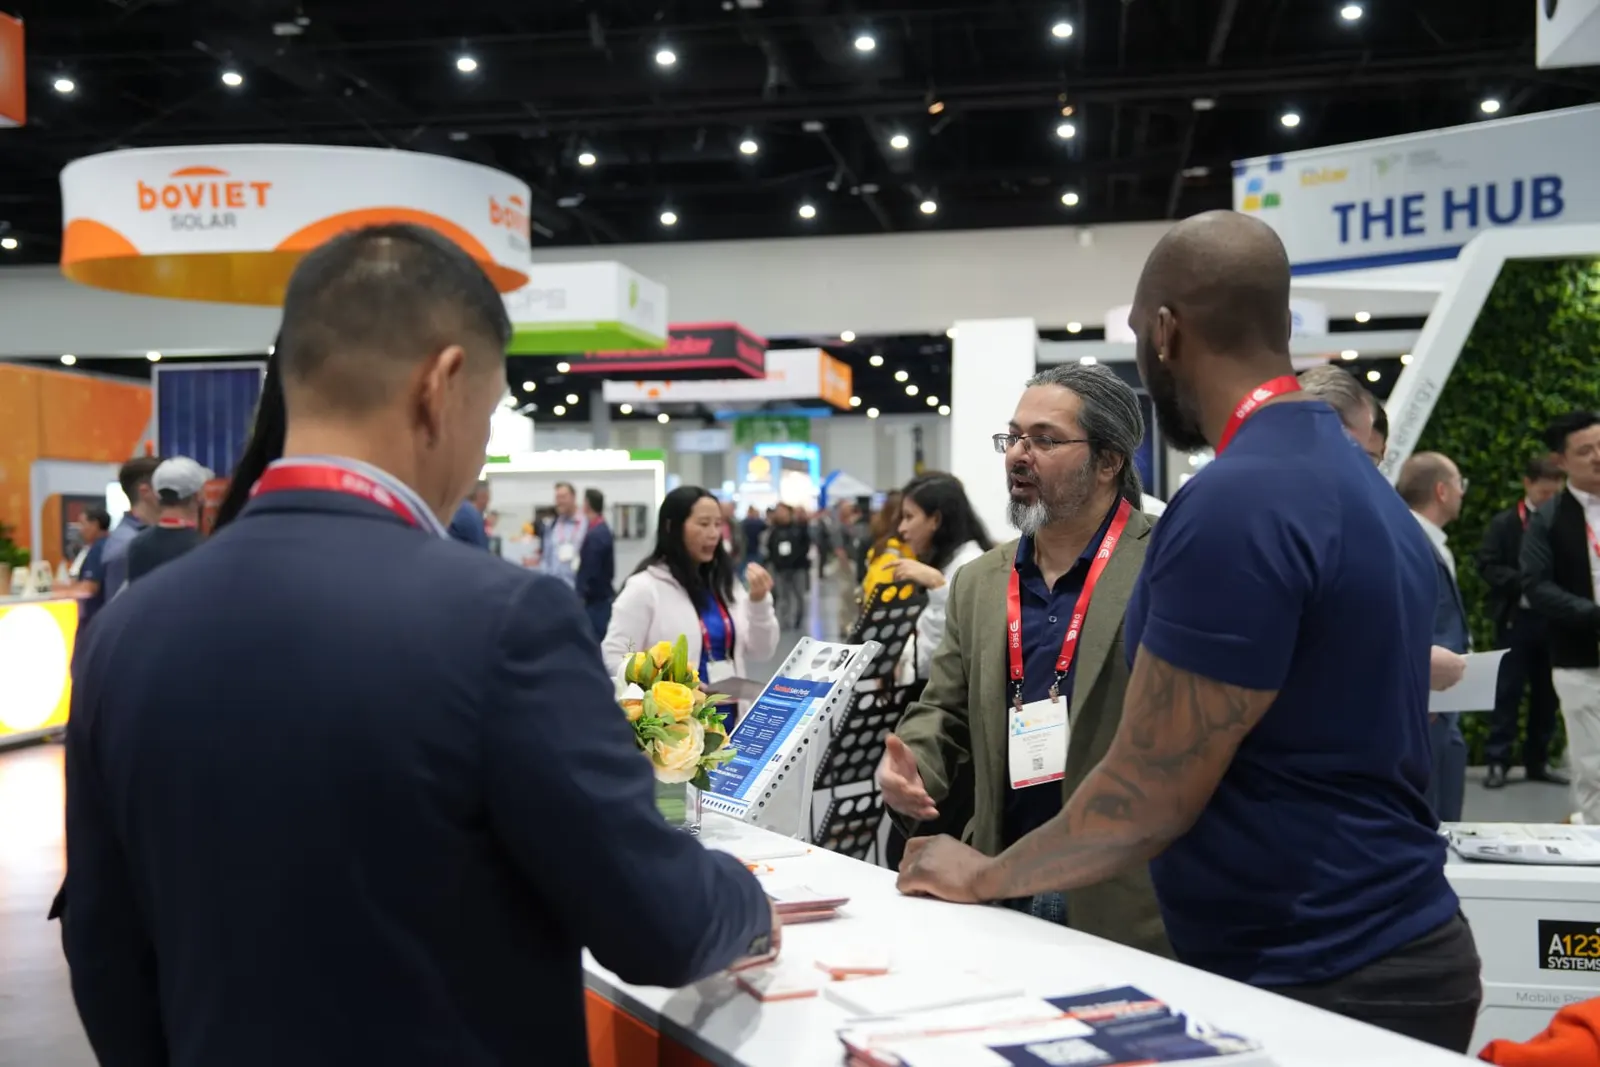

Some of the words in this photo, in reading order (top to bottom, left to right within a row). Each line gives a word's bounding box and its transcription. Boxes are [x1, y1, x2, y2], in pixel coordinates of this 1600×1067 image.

[1332, 192, 1426, 244] THE
[1442, 173, 1565, 232] HUB
[170, 212, 238, 231] SOLAR
[1548, 933, 1600, 957] A123
[1516, 991, 1560, 1004] Mobile
